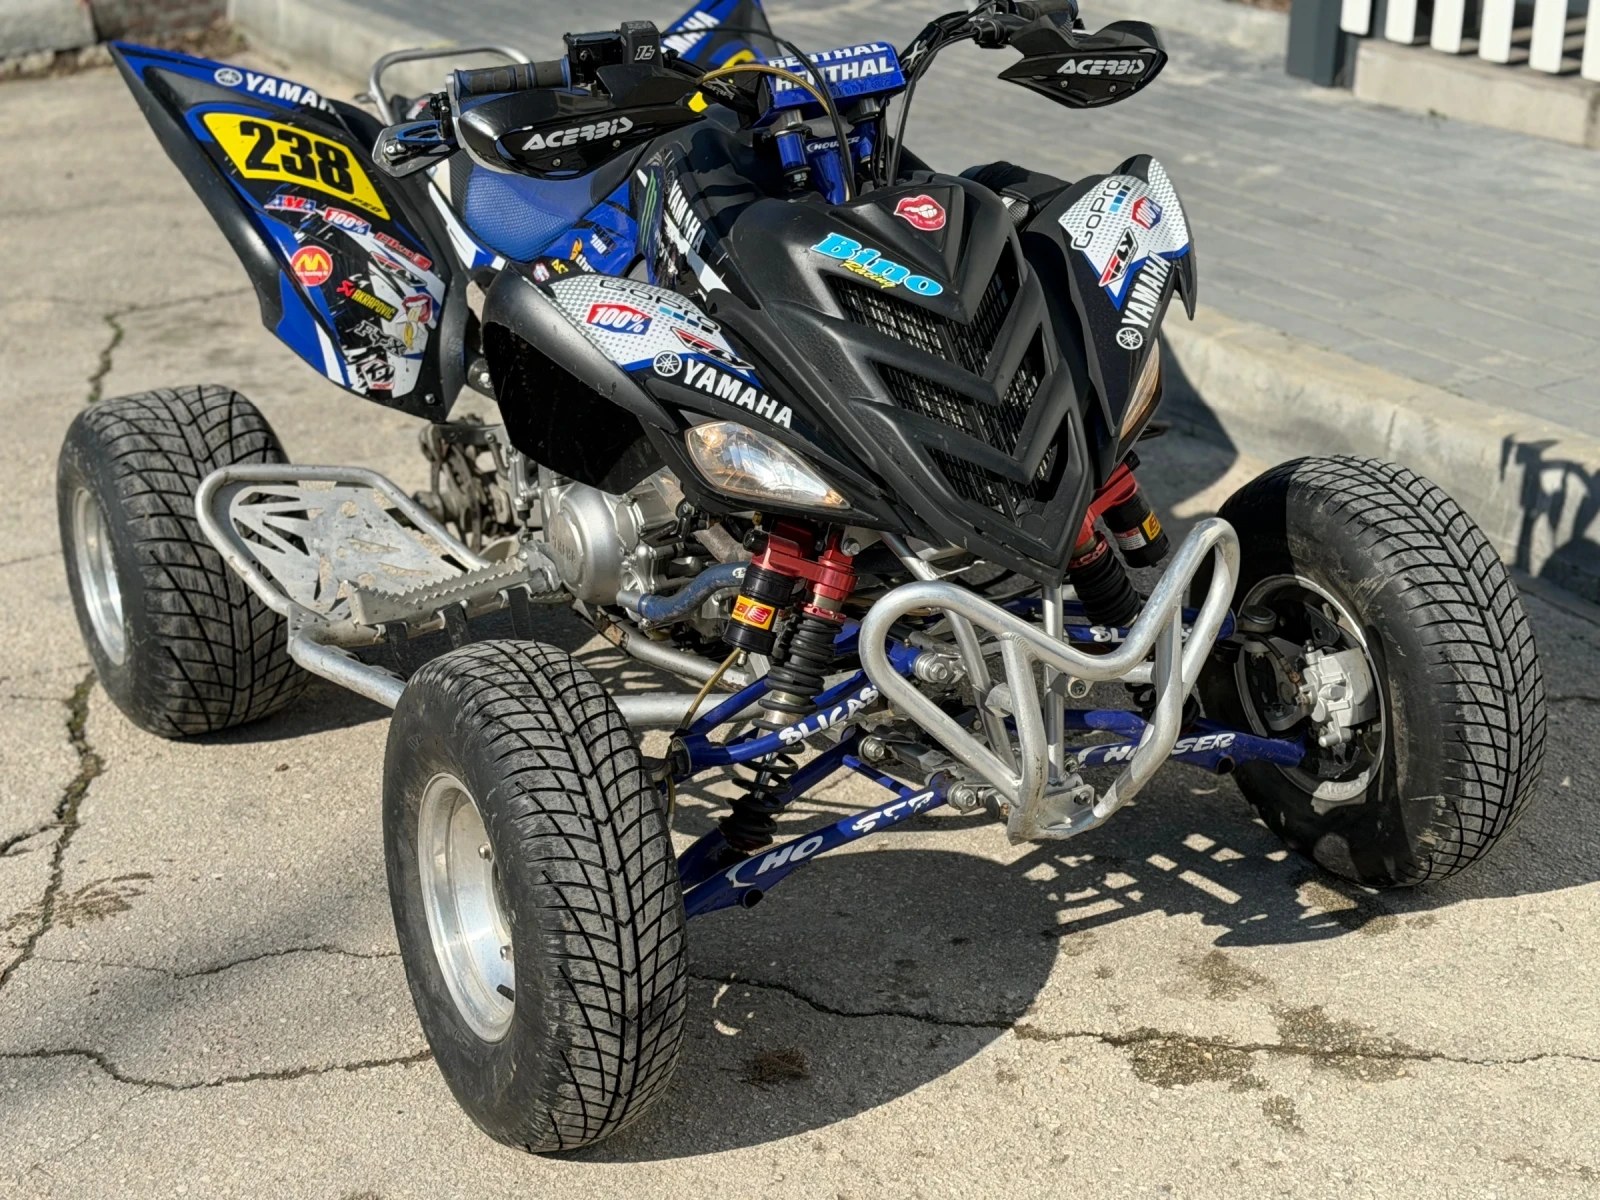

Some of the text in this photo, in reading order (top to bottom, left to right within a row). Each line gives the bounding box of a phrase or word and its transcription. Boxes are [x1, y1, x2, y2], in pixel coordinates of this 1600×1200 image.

[660, 11, 719, 58] MAHA
[240, 120, 354, 194] 238
[328, 210, 366, 233] 100%
[668, 180, 706, 254] YAMAHA
[1136, 199, 1162, 226] 100%
[810, 232, 943, 296] Bino
[1121, 251, 1171, 329] YAMAHA
[592, 306, 645, 332] 100%
[683, 358, 792, 428] YAMAHA
